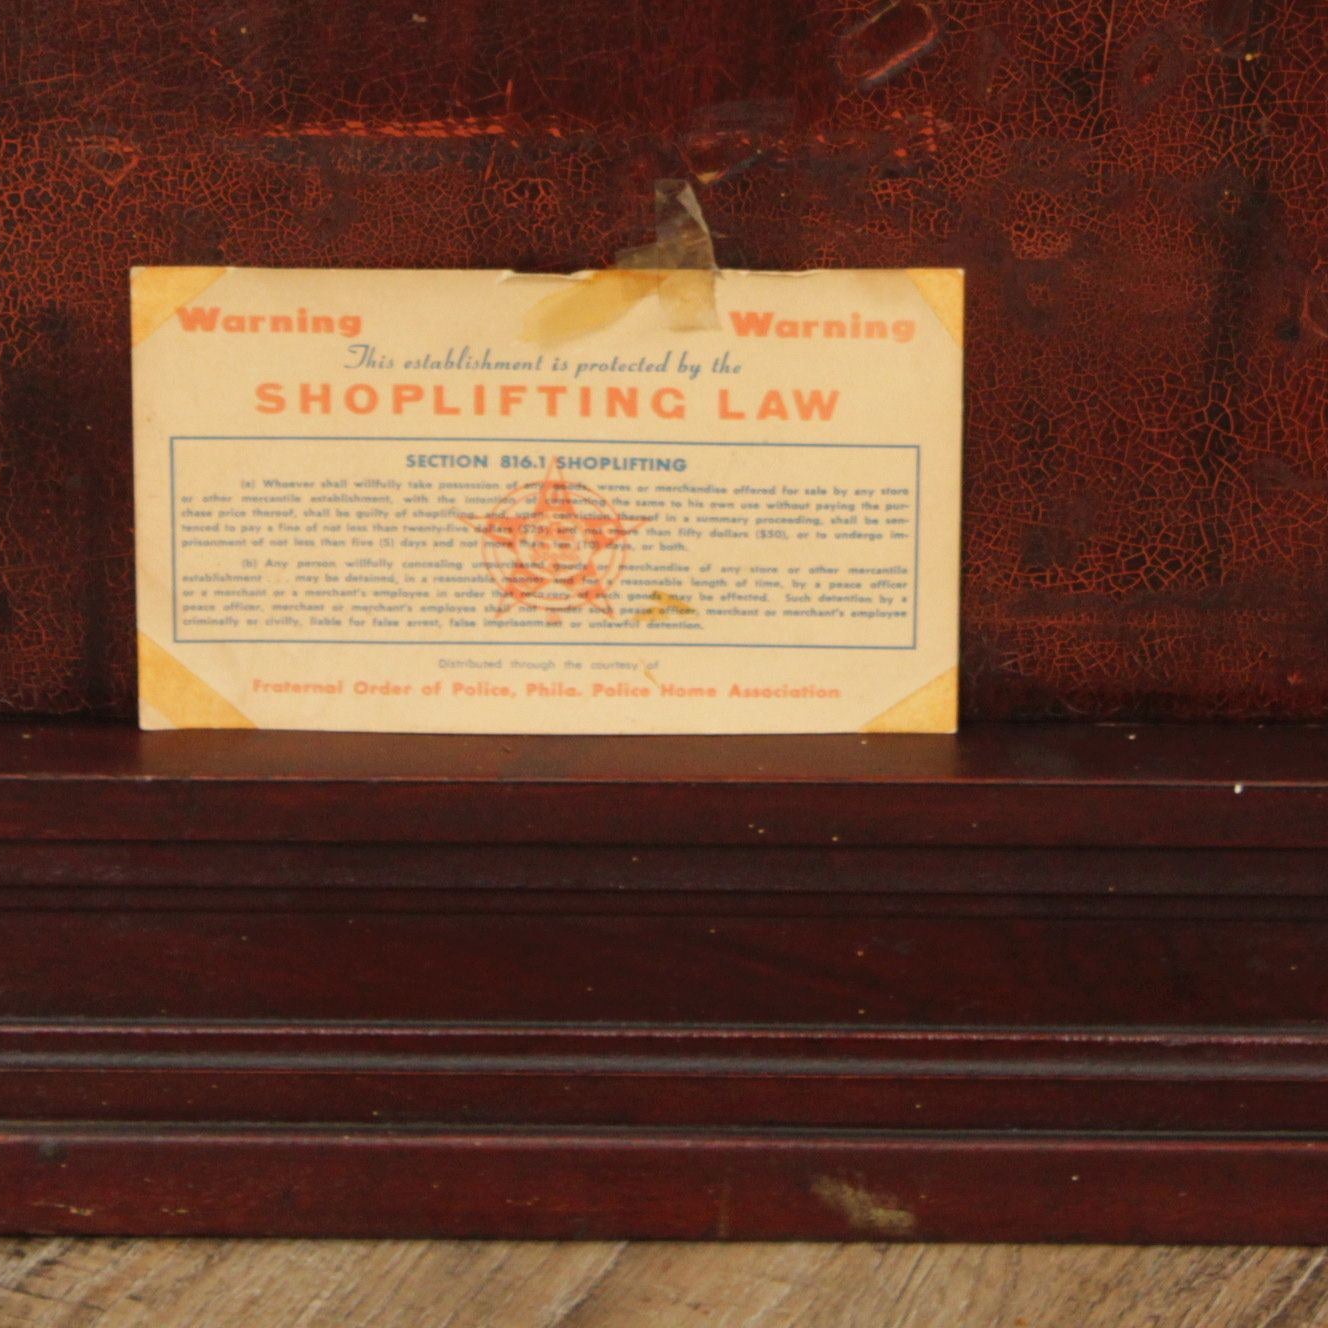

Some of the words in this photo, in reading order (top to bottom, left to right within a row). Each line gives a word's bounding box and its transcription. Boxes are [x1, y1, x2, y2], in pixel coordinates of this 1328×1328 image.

[175, 306, 362, 338] Warning
[729, 311, 915, 343] Warning
[343, 344, 395, 371] This
[404, 346, 543, 373] establishment
[552, 355, 569, 372] is
[574, 350, 672, 379] protected
[677, 350, 702, 381] by
[711, 350, 742, 375] the
[255, 382, 687, 421] SHOPLIFTING
[718, 388, 840, 422] LAW
[406, 453, 489, 469] SECTION
[500, 454, 546, 470] 816.1
[556, 455, 688, 472] SHOPLIFTING
[511, 658, 556, 672] through
[564, 659, 583, 670] the
[590, 660, 639, 672] courtesy
[646, 659, 660, 670] of
[253, 678, 343, 695] Fraternal
[355, 680, 412, 696] Order
[422, 681, 442, 696] of
[452, 682, 517, 699] Police,
[526, 682, 582, 698] Phila.
[592, 682, 651, 698] Police
[660, 683, 718, 698] Home
[728, 683, 842, 699] Association
